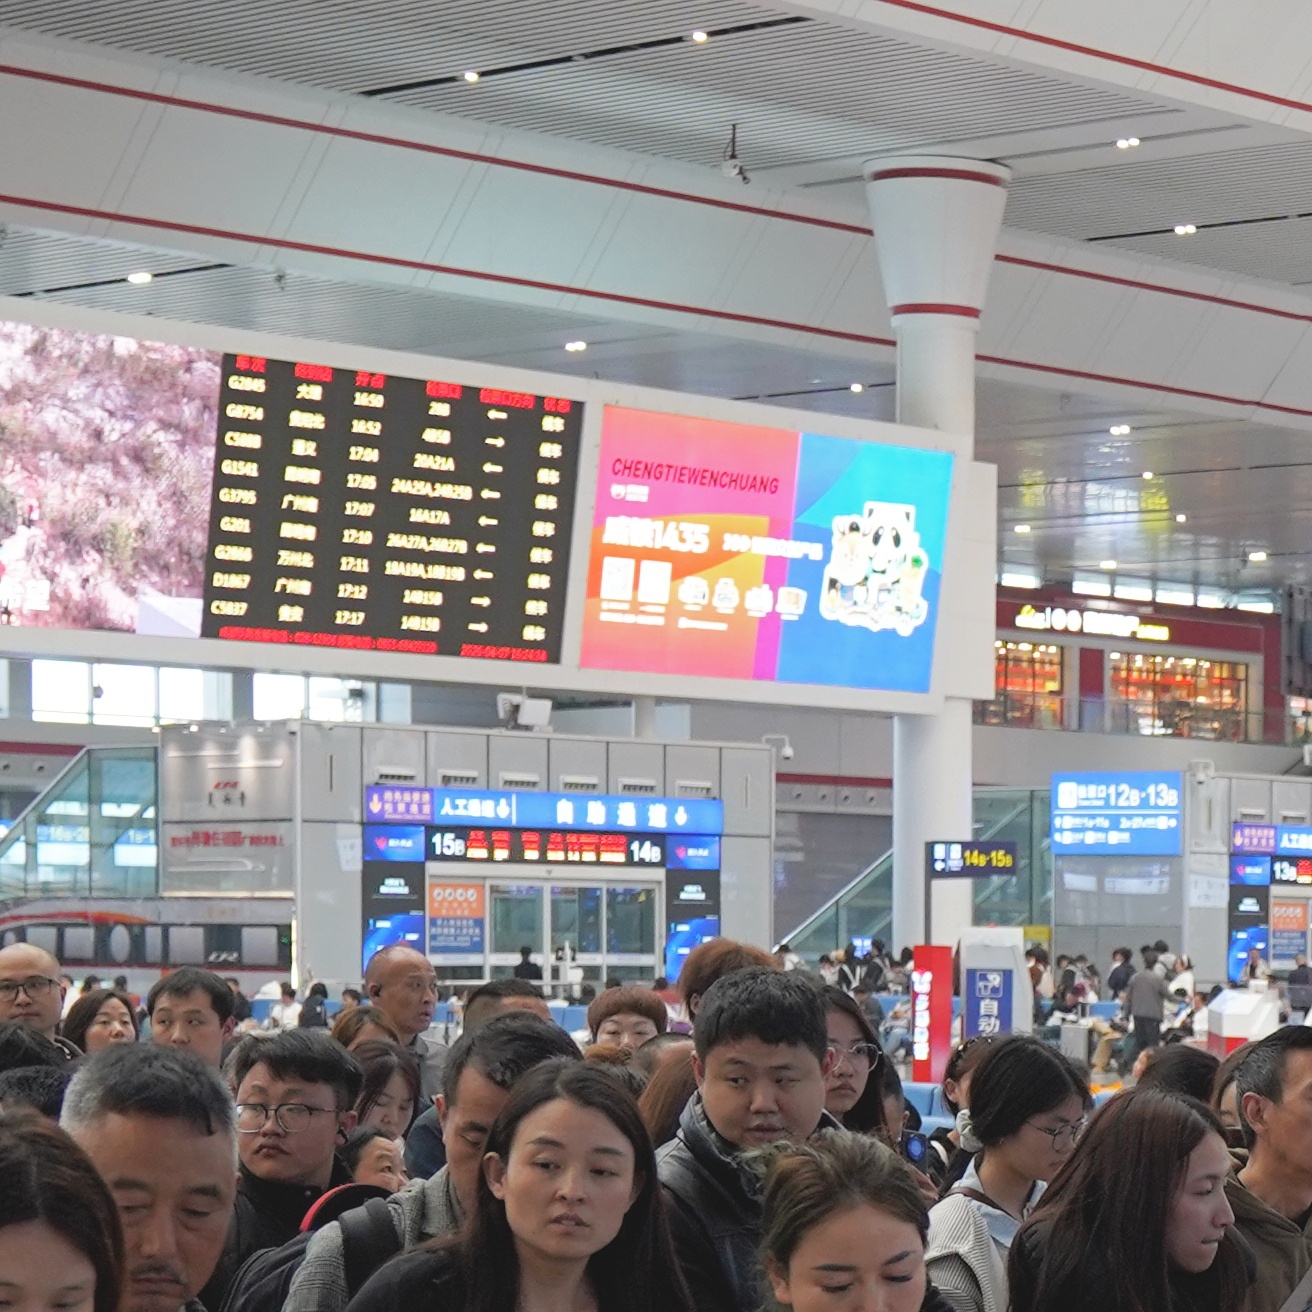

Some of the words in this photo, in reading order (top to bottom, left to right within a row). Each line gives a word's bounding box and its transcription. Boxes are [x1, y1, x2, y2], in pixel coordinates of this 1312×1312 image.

[612, 458, 780, 495] CHENGTIEWENCHUANG
[556, 798, 667, 829] 自助通道
[431, 832, 465, 857] 15B
[630, 840, 662, 864] 14B
